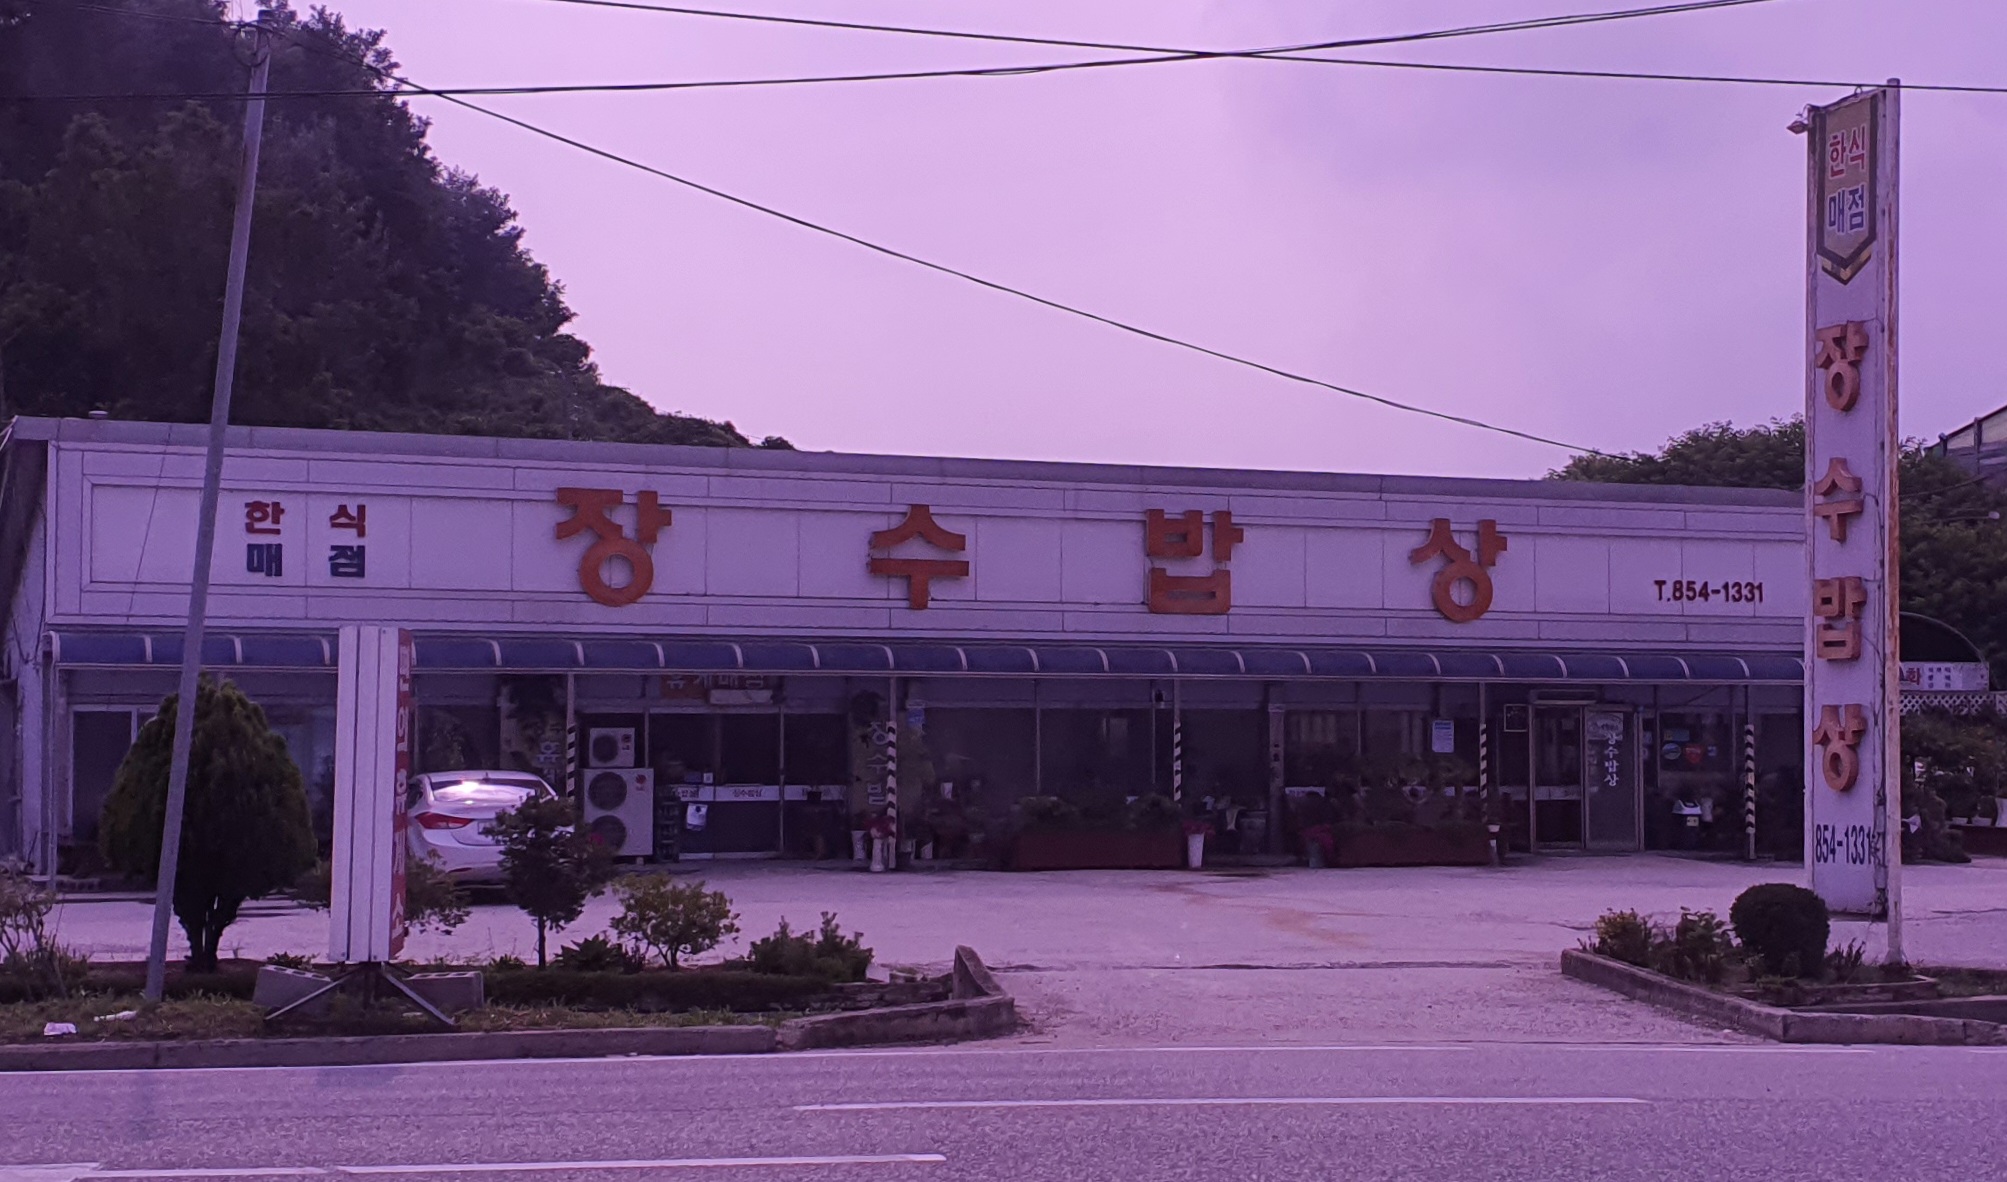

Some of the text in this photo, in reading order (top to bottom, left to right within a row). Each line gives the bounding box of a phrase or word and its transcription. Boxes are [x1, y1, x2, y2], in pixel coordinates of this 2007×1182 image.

[1829, 126, 1866, 178] 한식
[1827, 184, 1865, 232] 매점
[1654, 579, 1764, 603] T.854-1331
[1815, 824, 1872, 865] 854-1331
